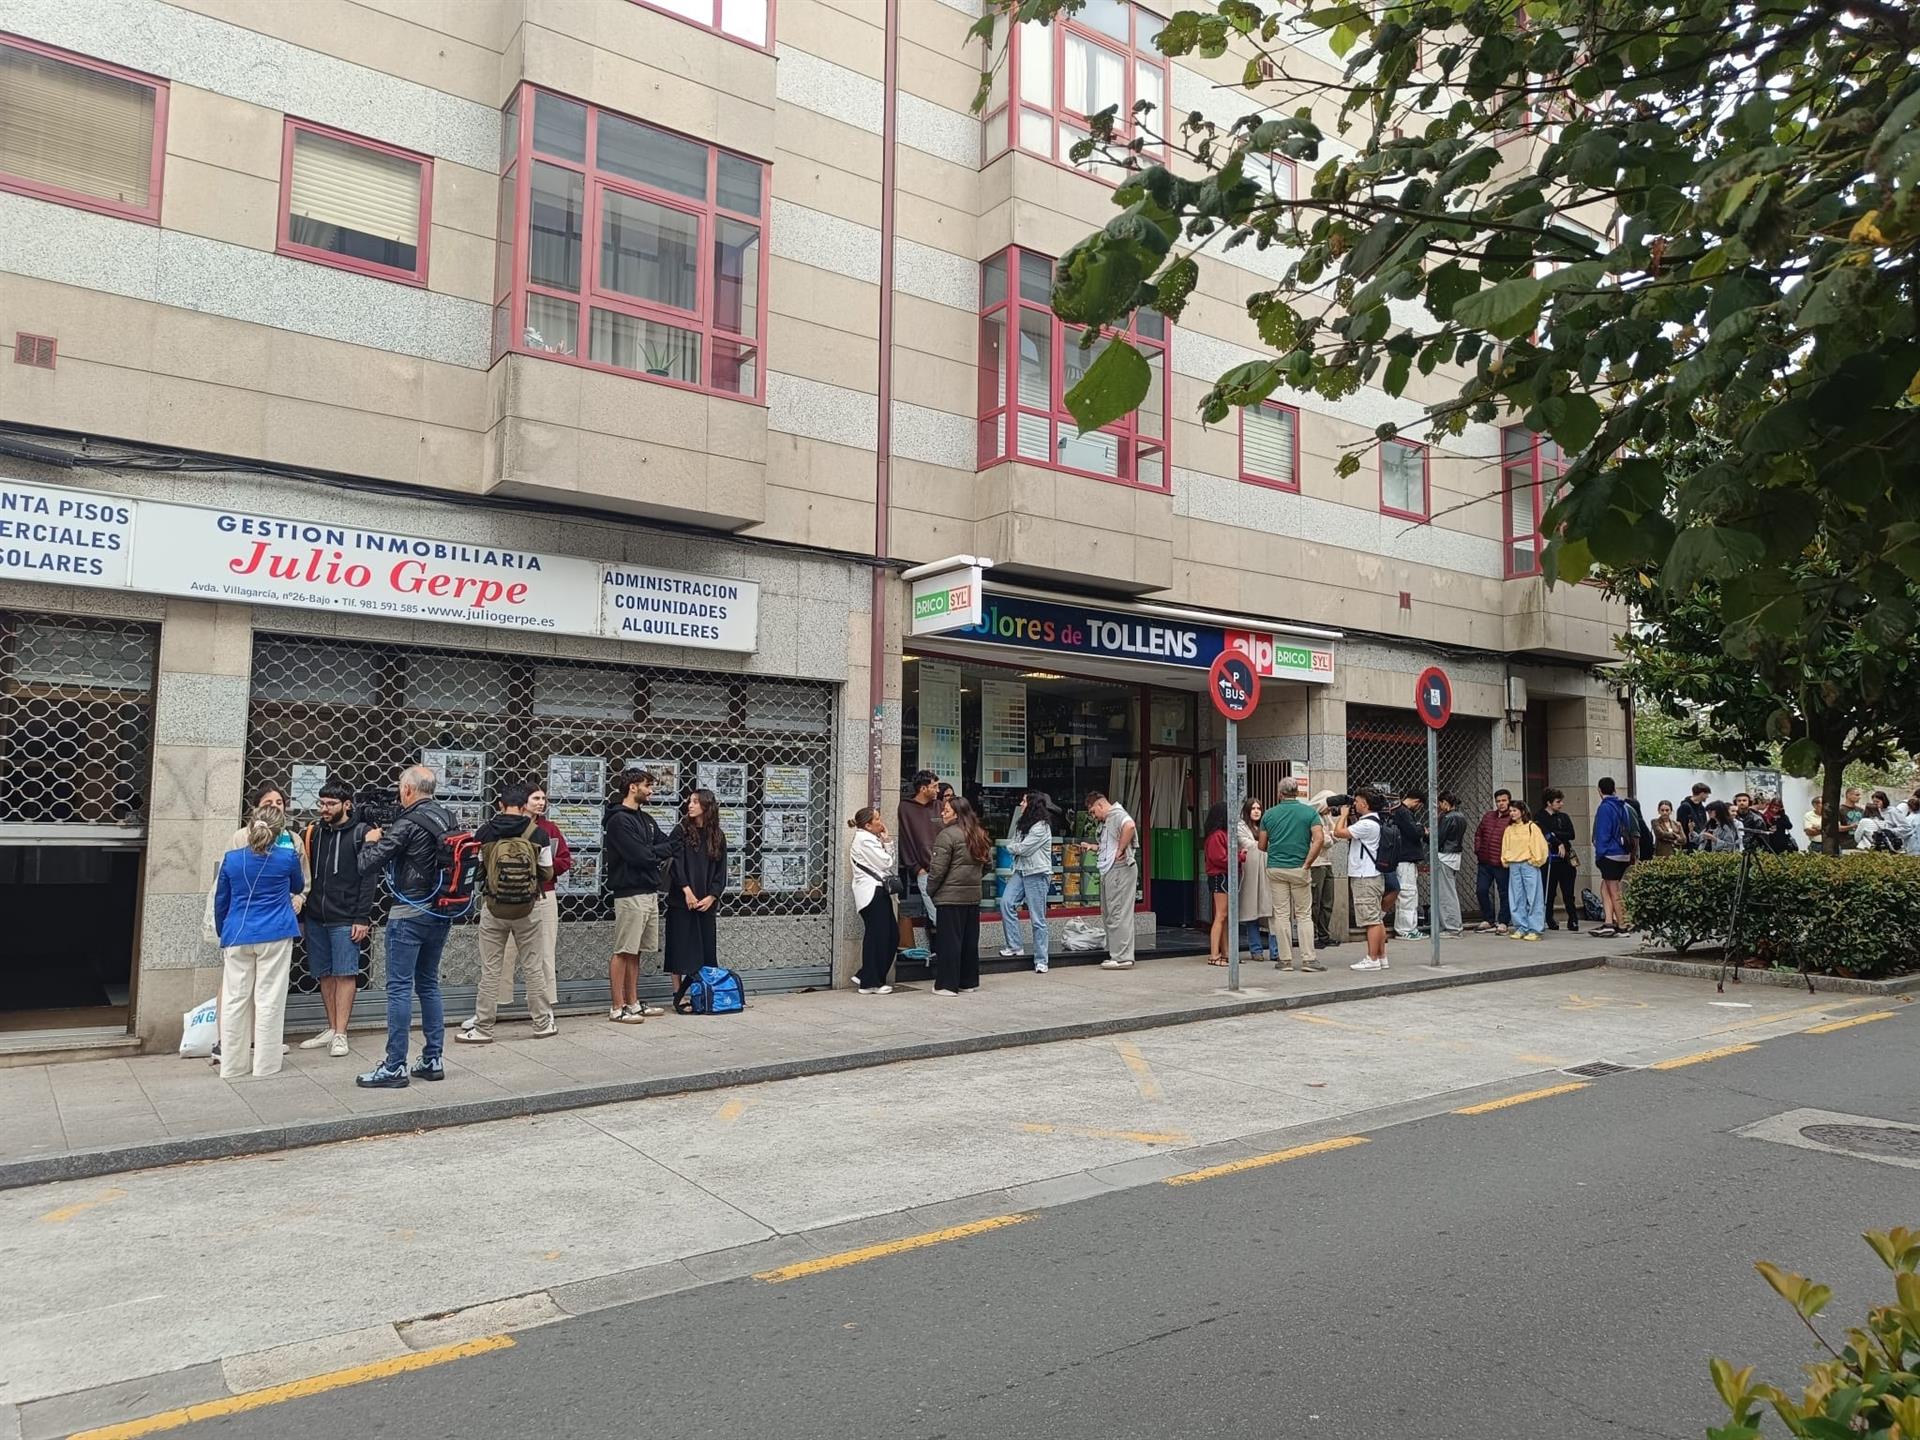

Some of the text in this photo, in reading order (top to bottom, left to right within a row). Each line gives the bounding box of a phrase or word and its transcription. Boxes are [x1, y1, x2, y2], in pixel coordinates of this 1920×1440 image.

[1, 492, 129, 525] NTA PISOS
[0, 520, 121, 551] ERCIALES
[217, 515, 541, 571] GESTION INMOBILIARIA
[229, 541, 528, 608] Julio Gerpe
[603, 571, 738, 600] ADMINISTRACION
[190, 581, 219, 593] Avda.
[360, 600, 377, 609] 981
[380, 602, 397, 611] 591
[400, 603, 418, 613] 585
[427, 606, 555, 627] www.juliogerpe.es
[615, 594, 727, 620] COMUNIDADES
[916, 591, 967, 615] BRICO SYL
[622, 617, 719, 640] ALQUILERES
[960, 606, 1198, 658] olores de TOLLENS
[1277, 651, 1328, 668] BRICO SYL
[1233, 672, 1239, 682] P
[1225, 688, 1245, 700] BUS
